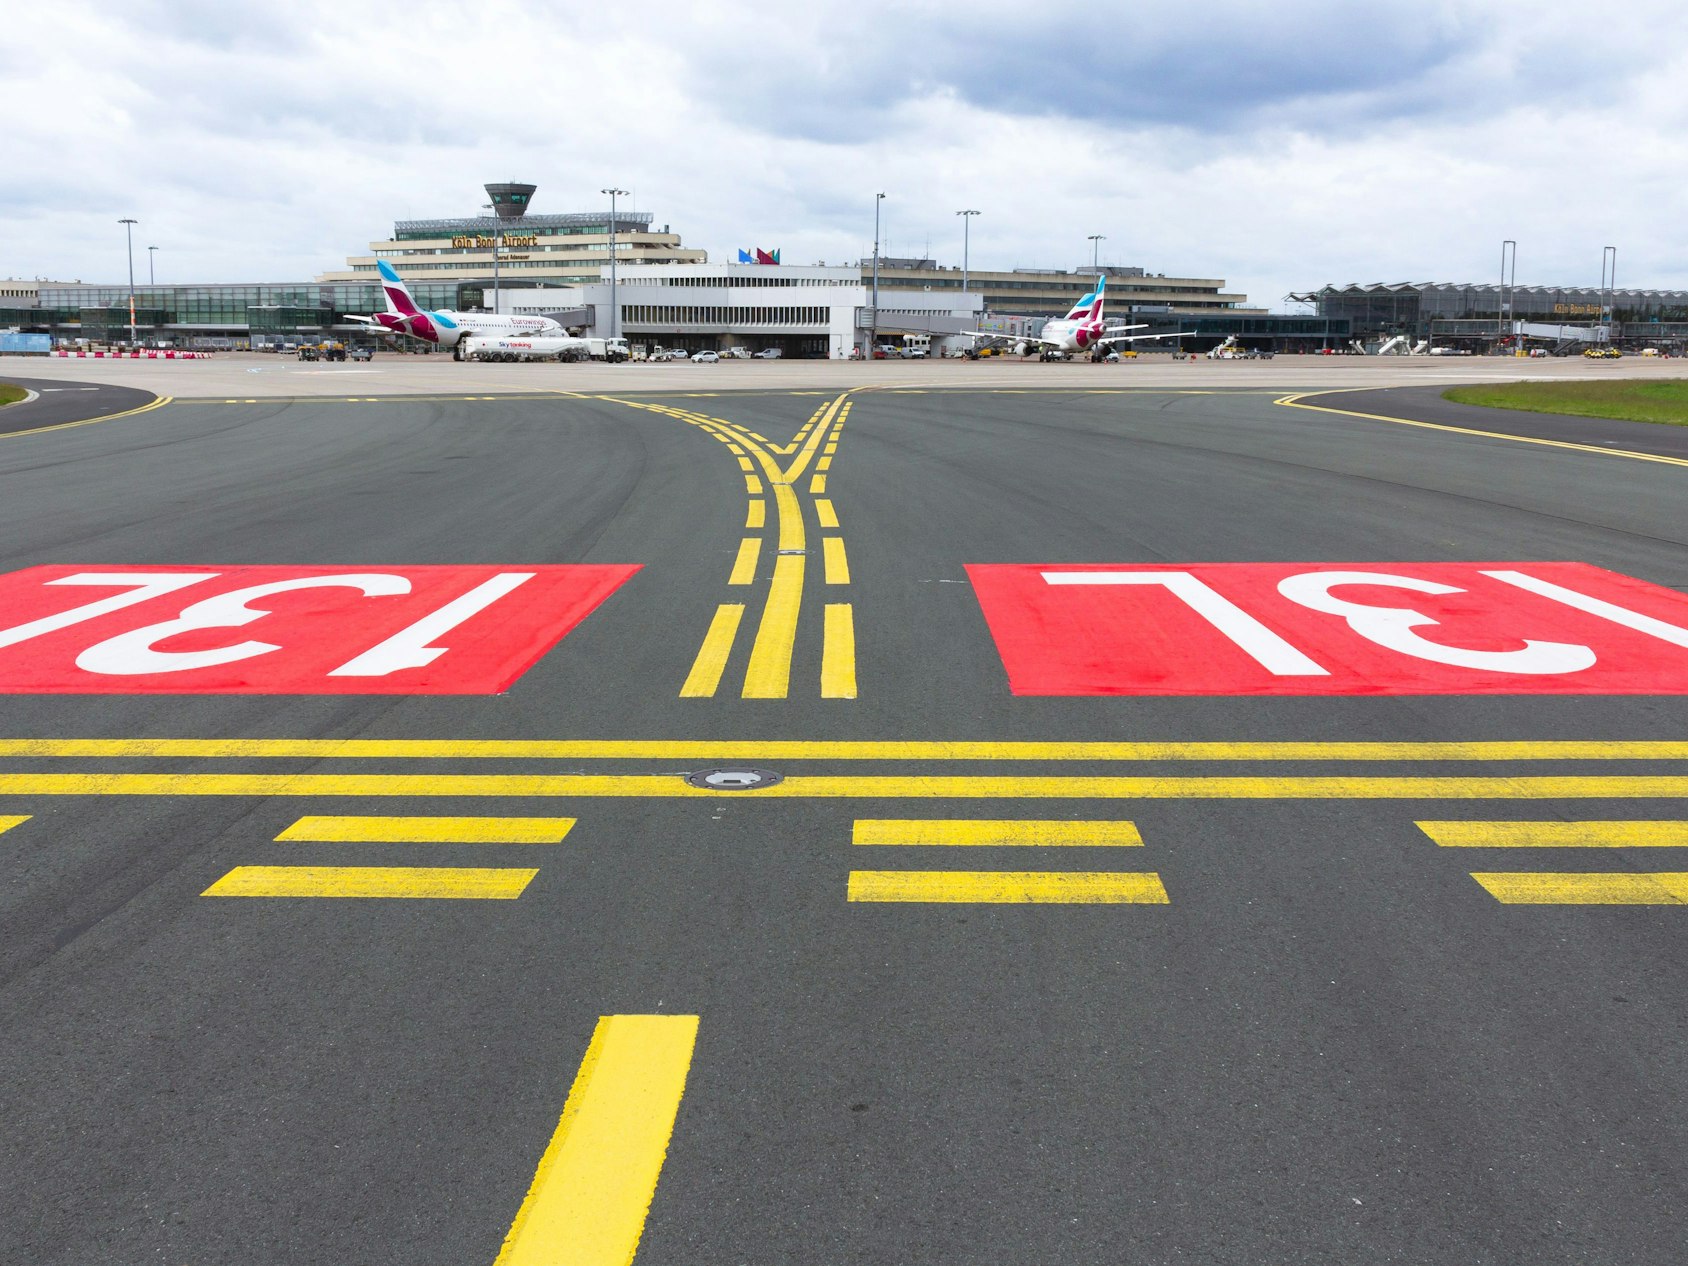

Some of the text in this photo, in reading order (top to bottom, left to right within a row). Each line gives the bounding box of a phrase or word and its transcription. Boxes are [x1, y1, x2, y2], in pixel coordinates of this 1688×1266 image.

[452, 235, 472, 249] Köln
[502, 233, 538, 249] Airport
[510, 317, 547, 326] Eurowings
